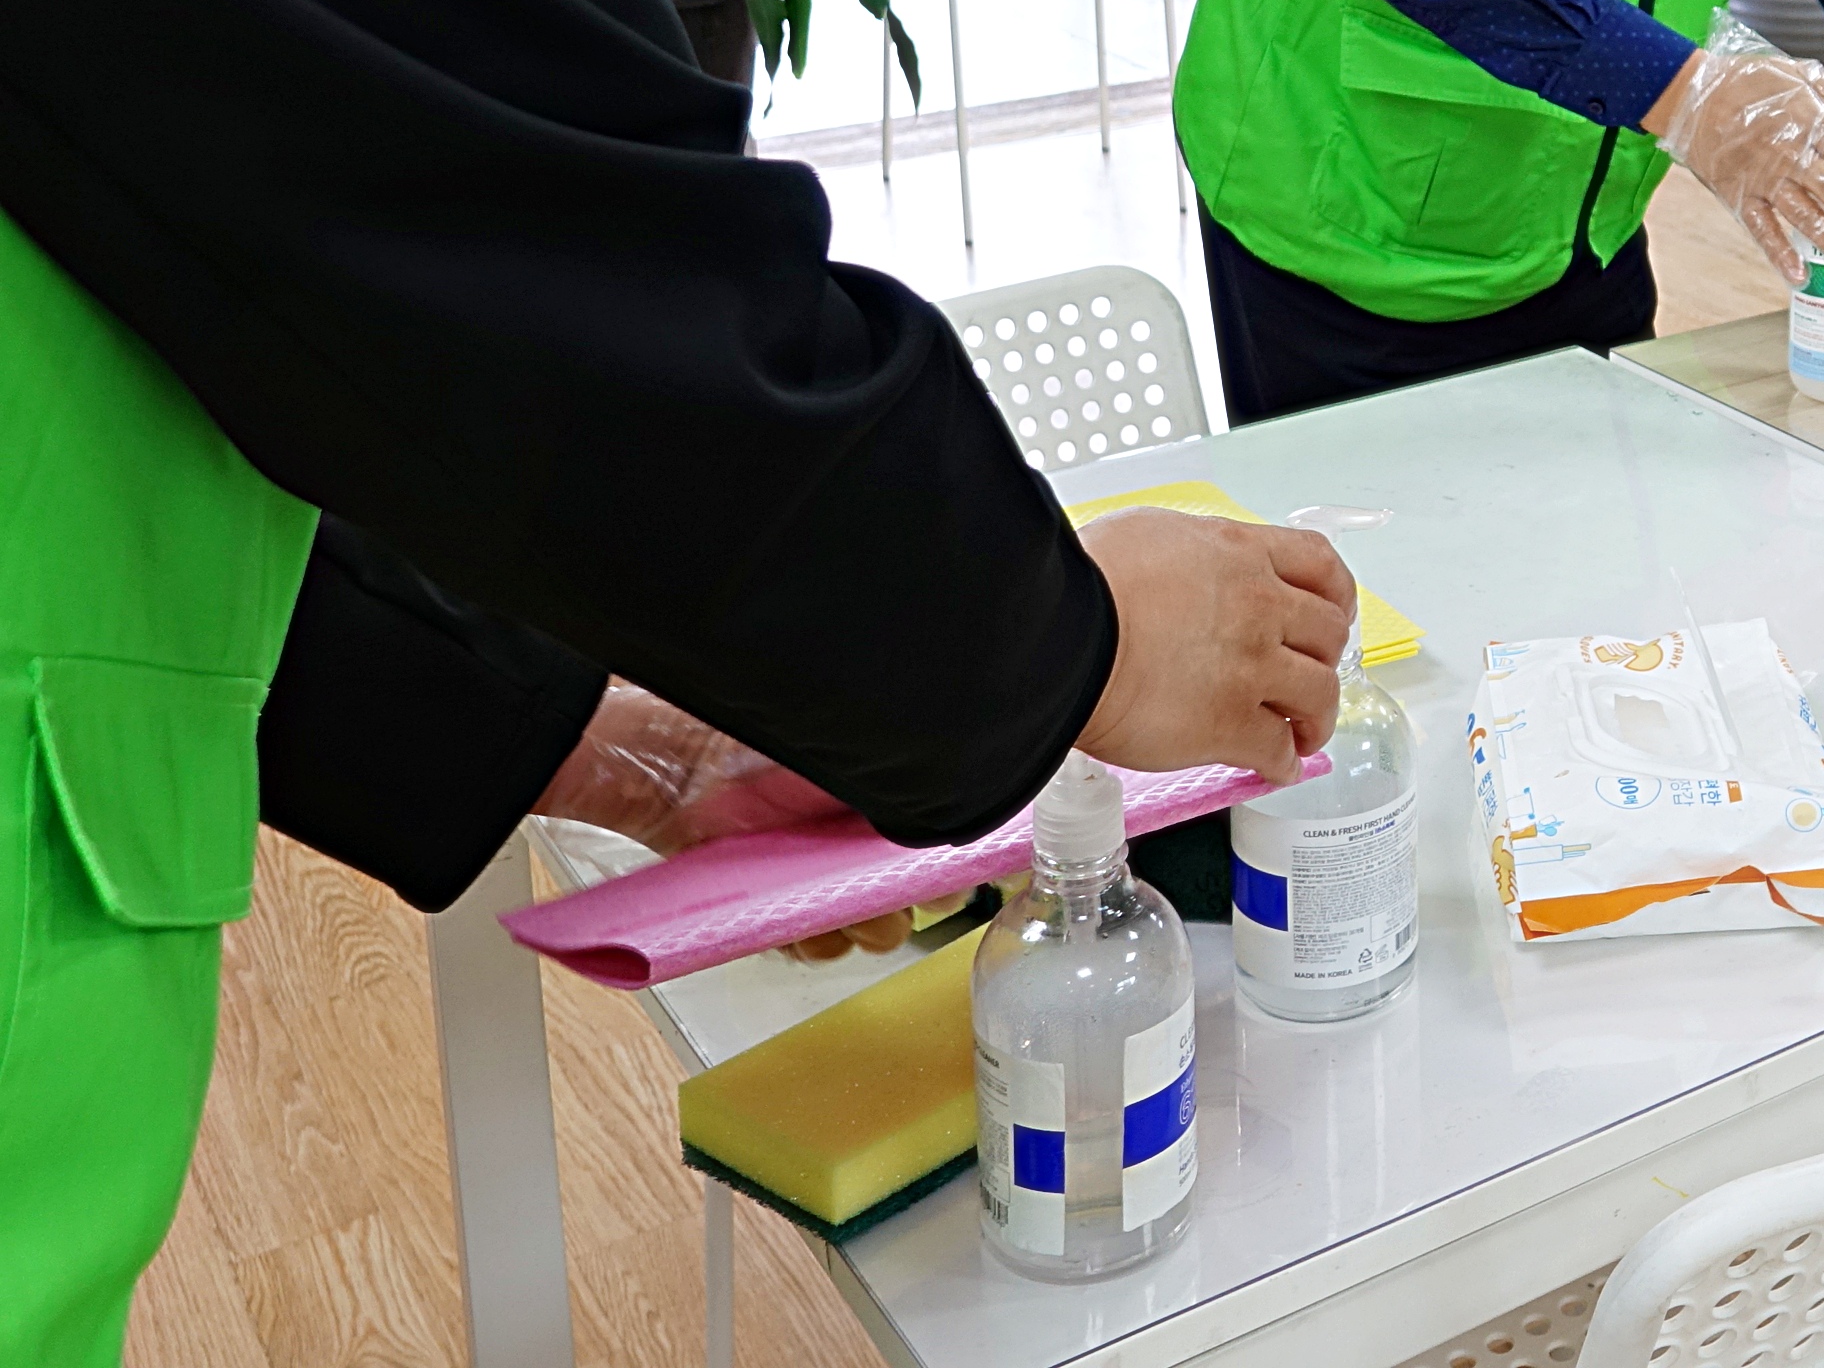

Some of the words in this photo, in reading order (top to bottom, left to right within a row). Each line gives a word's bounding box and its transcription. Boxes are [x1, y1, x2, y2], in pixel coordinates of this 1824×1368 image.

[1618, 778, 1639, 806] 00매
[1668, 779, 1694, 806] 장갑
[1303, 830, 1329, 838] CLEAN
[1338, 824, 1364, 836] FRESH
[1364, 817, 1383, 831] FIRST
[1328, 969, 1353, 978] KOREA
